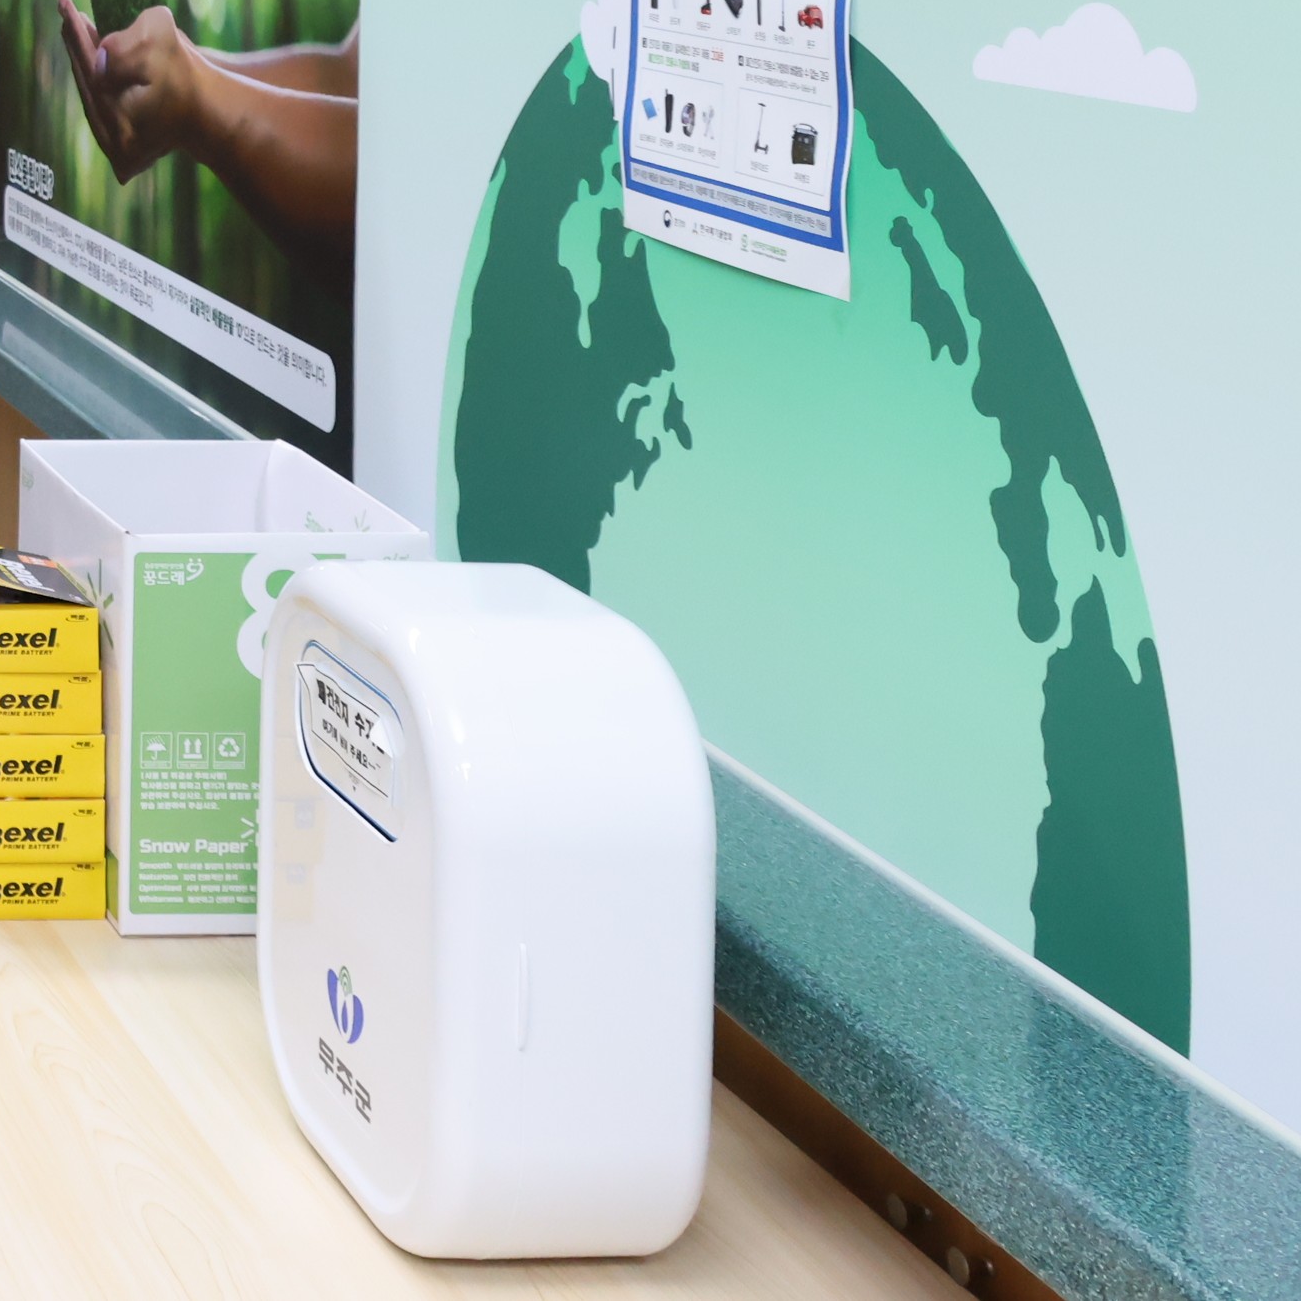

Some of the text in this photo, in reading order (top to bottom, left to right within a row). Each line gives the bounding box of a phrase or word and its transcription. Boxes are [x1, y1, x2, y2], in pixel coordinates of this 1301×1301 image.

[143, 570, 185, 586] 꿈드래
[139, 838, 249, 856] Snow Paper
[317, 1035, 373, 1125] 무주군
